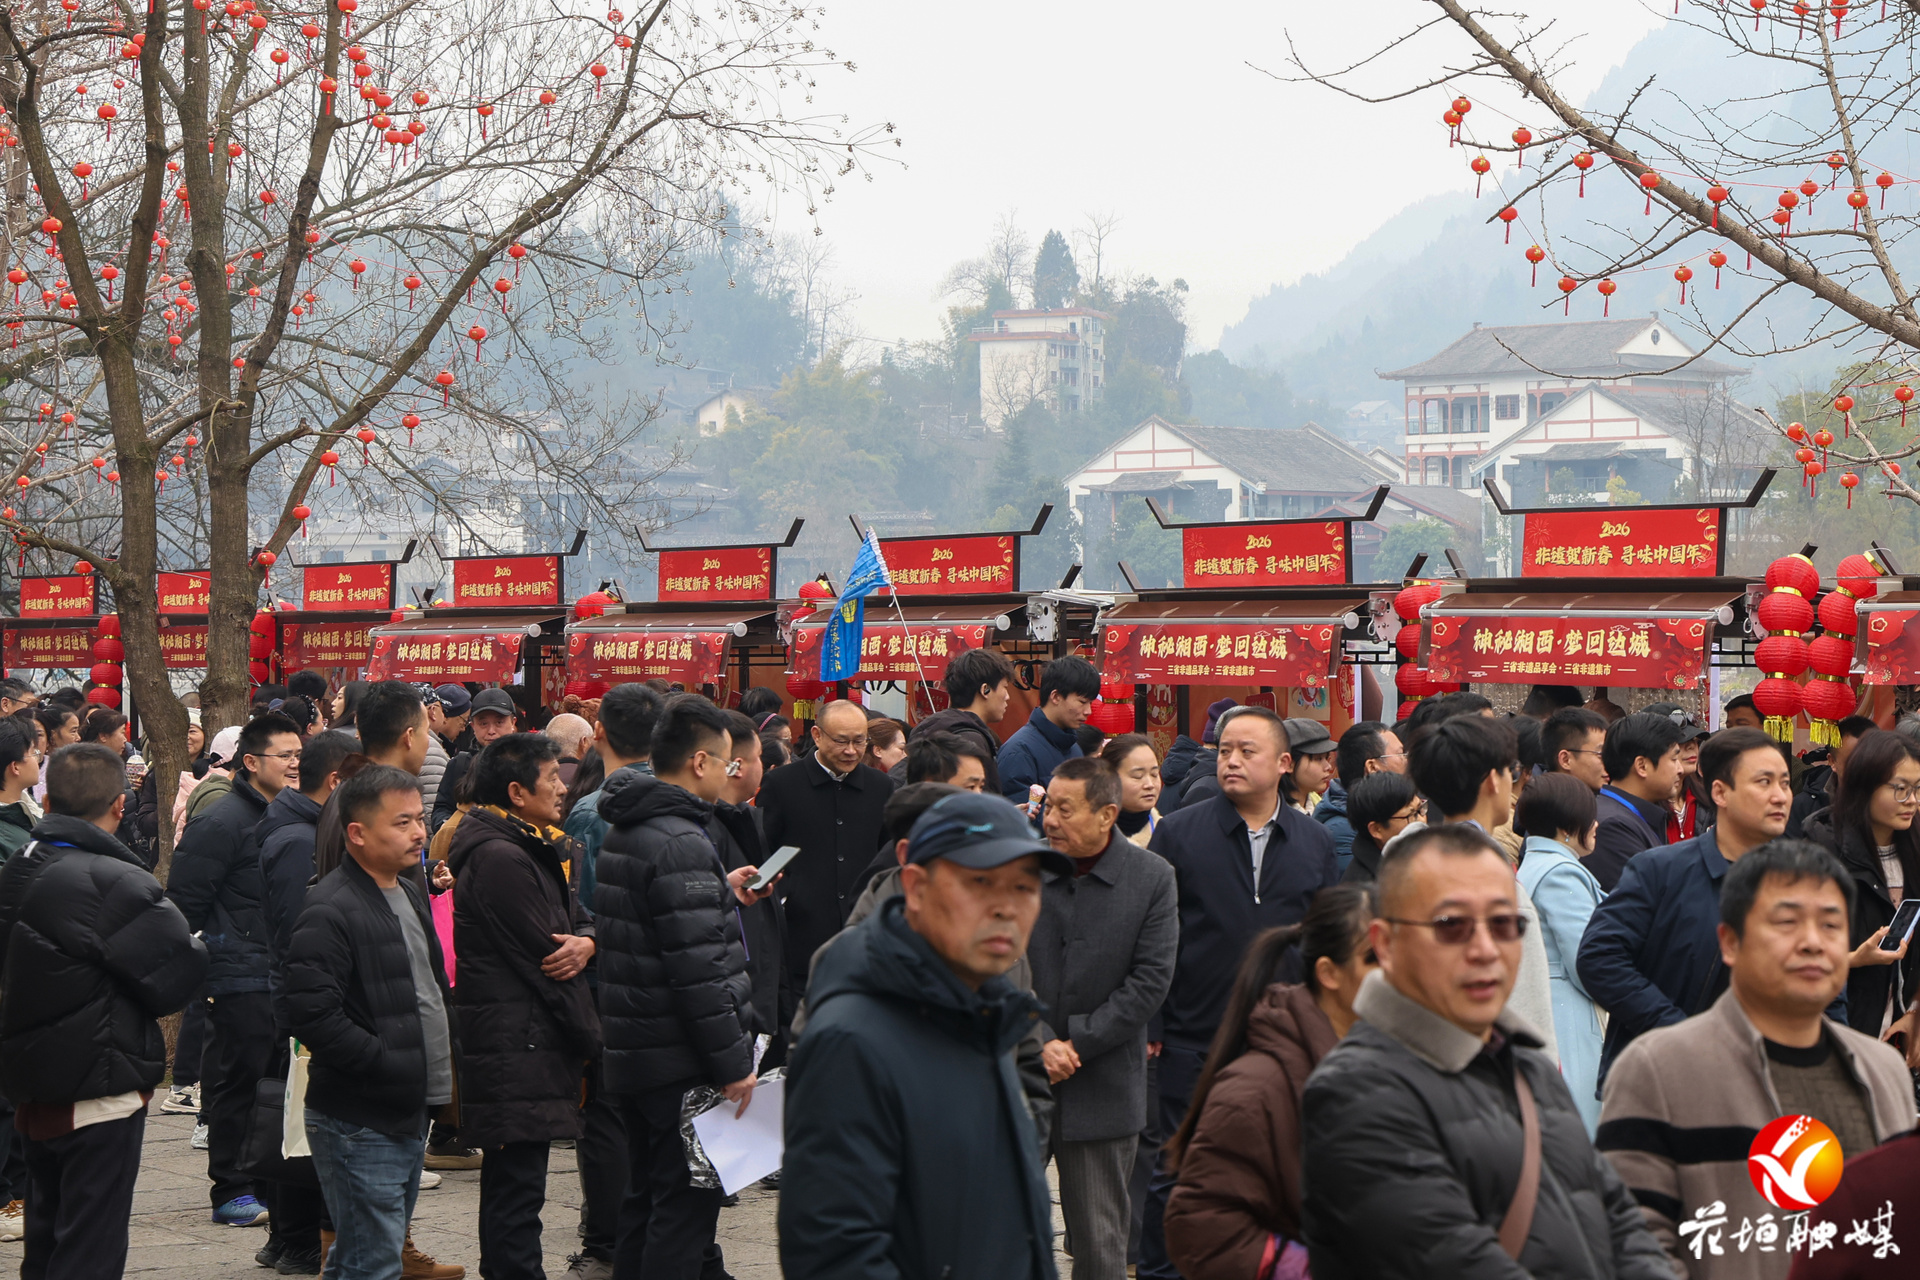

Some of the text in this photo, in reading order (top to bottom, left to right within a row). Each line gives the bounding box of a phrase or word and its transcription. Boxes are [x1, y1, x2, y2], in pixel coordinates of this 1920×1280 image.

[1599, 521, 1630, 538] 2026
[1245, 535, 1272, 550] 2026
[931, 548, 953, 562] 2026
[1535, 544, 1700, 566] 非遗贺新春 寻味中国年
[494, 566, 511, 578] 2026
[702, 558, 720, 570] 2026
[1194, 554, 1331, 575] 非遗贺新春 寻味中国年
[947, 565, 1002, 583] 寻味中国年
[461, 581, 549, 597] 非遗贺新春 寻味中国年
[666, 575, 762, 591] 非遗贺新春 寻味中国年
[593, 640, 693, 661] 神秘湘西·梦回边城
[1140, 633, 1288, 660] 神秘湘西·梦回边城
[1473, 627, 1652, 658] 神秘湘西·梦回边城
[397, 641, 494, 661] 神秘湘西·梦回边城
[1167, 665, 1255, 676] 三省非遗品享会·三省非遗集市
[1502, 661, 1612, 675] 三省非遗品享会·三省非遗集市
